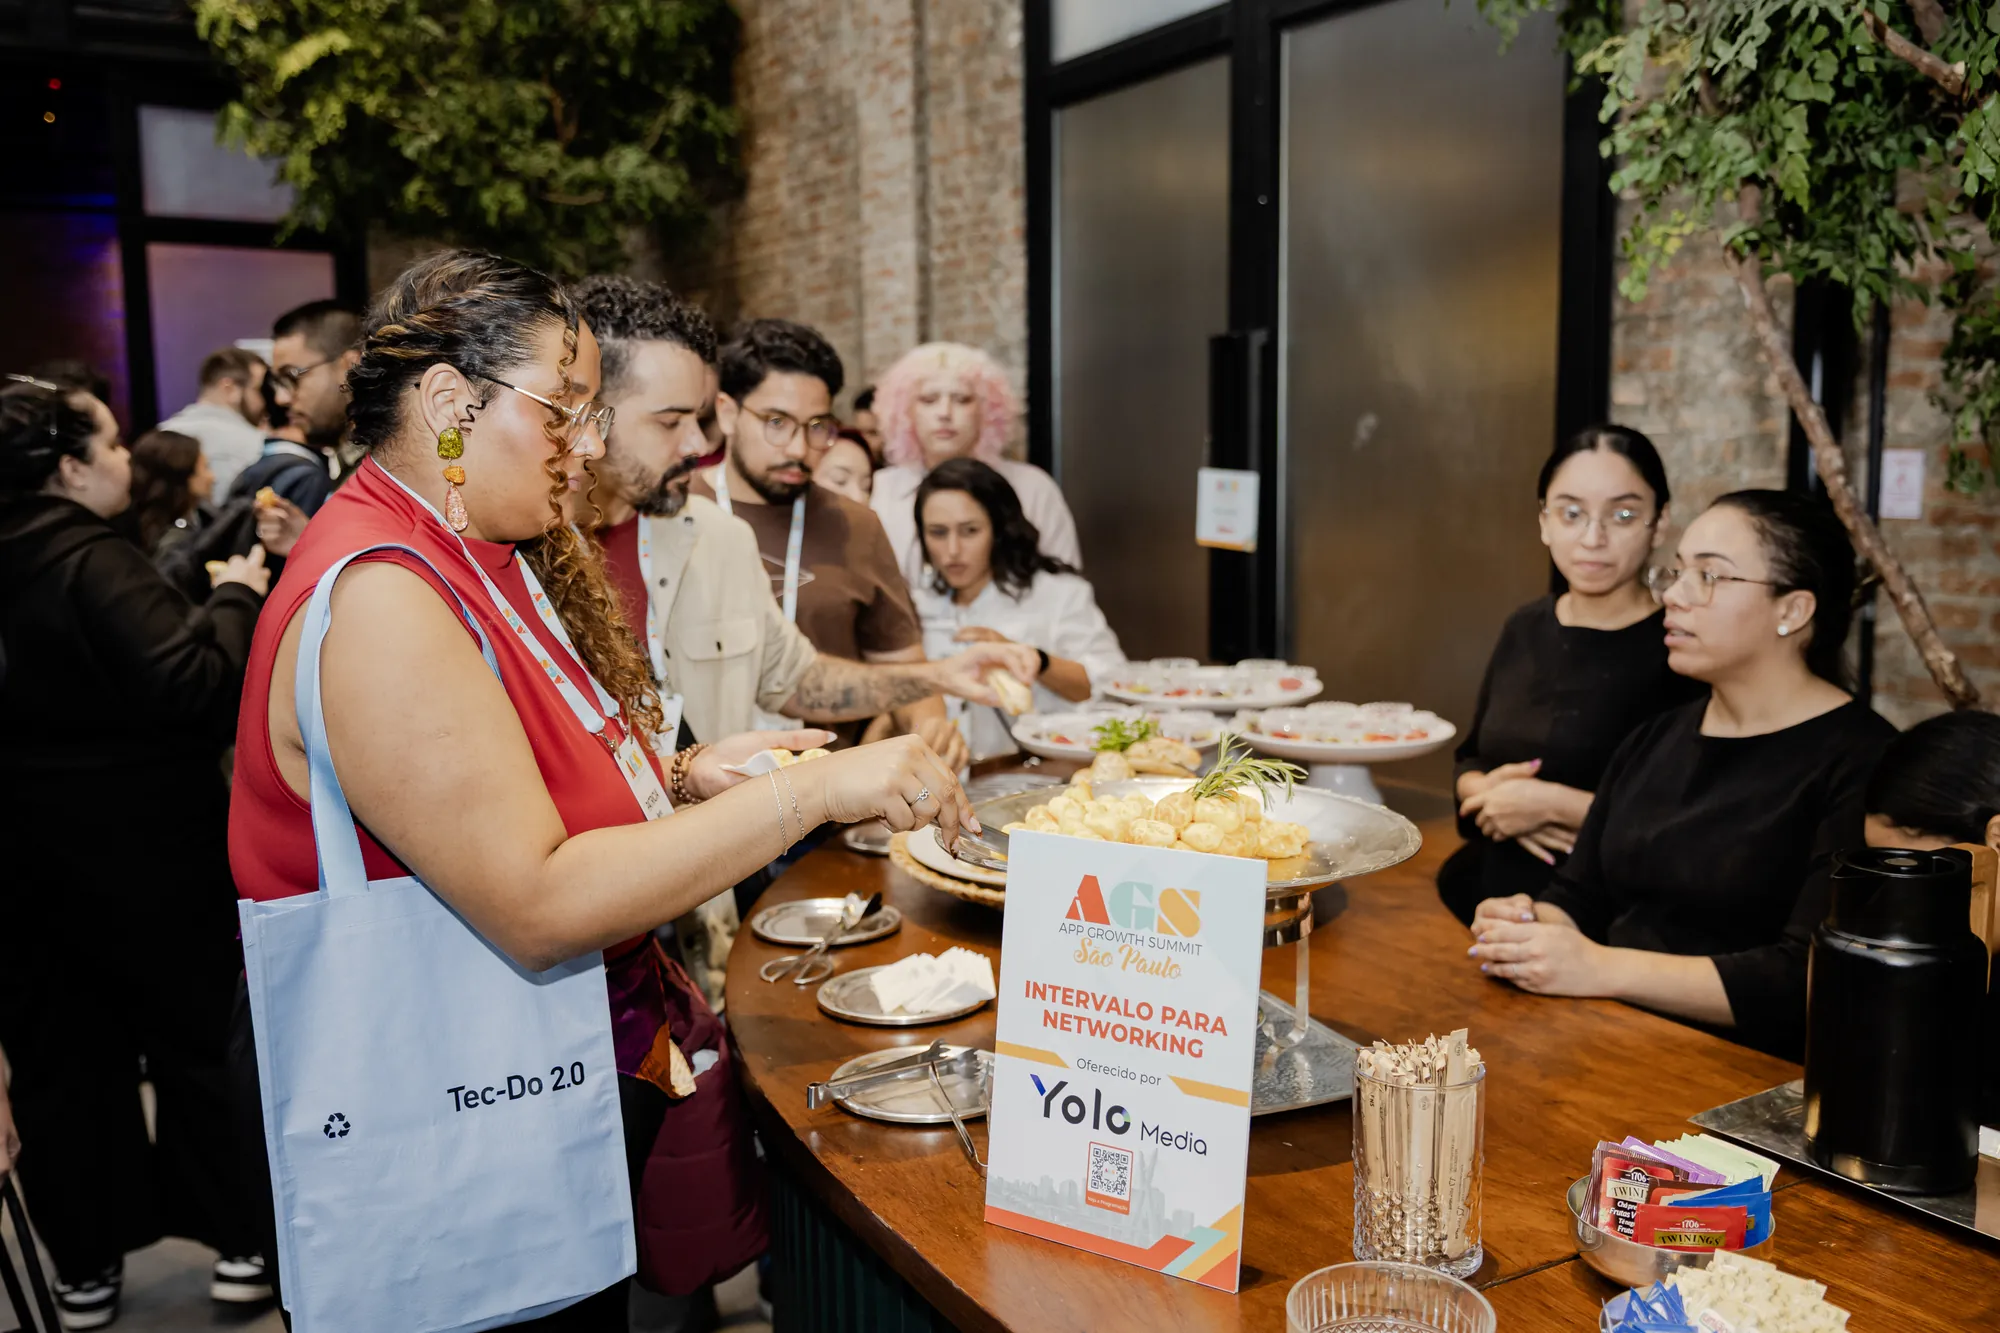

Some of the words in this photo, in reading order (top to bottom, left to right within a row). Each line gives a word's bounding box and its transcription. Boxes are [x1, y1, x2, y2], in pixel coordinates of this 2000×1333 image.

[1065, 874, 1201, 938] AGS
[1058, 922, 1085, 936] APP
[1087, 928, 1145, 947] GROWTH
[1148, 937, 1203, 956] SUMMIT
[1073, 937, 1113, 968] São
[1118, 943, 1182, 980] Paulo
[1025, 980, 1154, 1021] INTERVALO
[1161, 1006, 1228, 1036] PARA
[1043, 1009, 1203, 1058] NETWORKING
[447, 1075, 543, 1112] Tec-Do
[550, 1061, 585, 1091] 2.0
[1076, 1058, 1137, 1081] Oferecido
[1140, 1072, 1162, 1087] por
[1030, 1073, 1131, 1135] Yolo
[1140, 1121, 1207, 1156] Media
[1631, 1172, 1647, 1183] 1706
[1612, 1186, 1645, 1199] TWINI
[1627, 1203, 1637, 1211] pre
[1609, 1208, 1631, 1218] Frutas
[1681, 1220, 1700, 1228] 1706
[1617, 1225, 1635, 1235] Fruto
[1659, 1234, 1721, 1246] TWININGS
